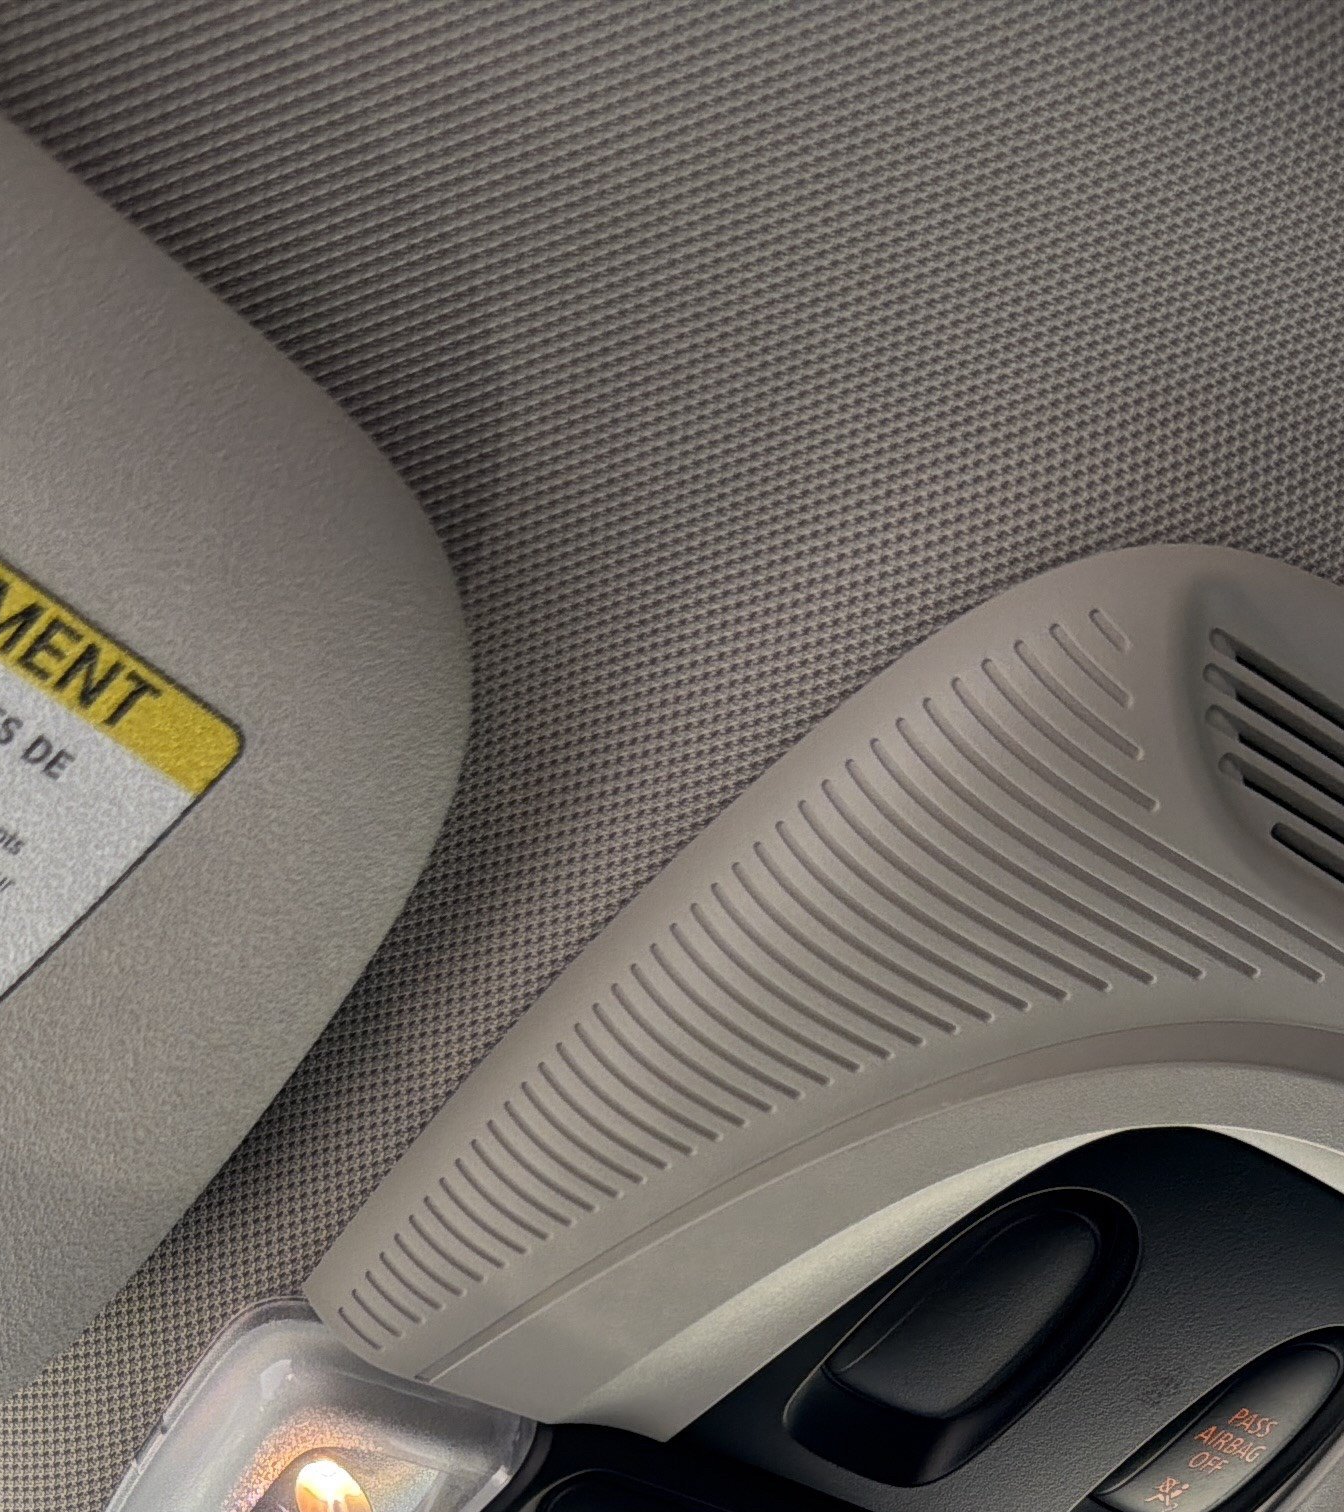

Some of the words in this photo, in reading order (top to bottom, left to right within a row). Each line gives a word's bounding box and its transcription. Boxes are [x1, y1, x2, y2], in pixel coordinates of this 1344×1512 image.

[21, 735, 74, 779] DE
[1227, 1407, 1279, 1438] PASS
[1194, 1425, 1267, 1463] AIRBAG
[1188, 1451, 1230, 1474] OFF
